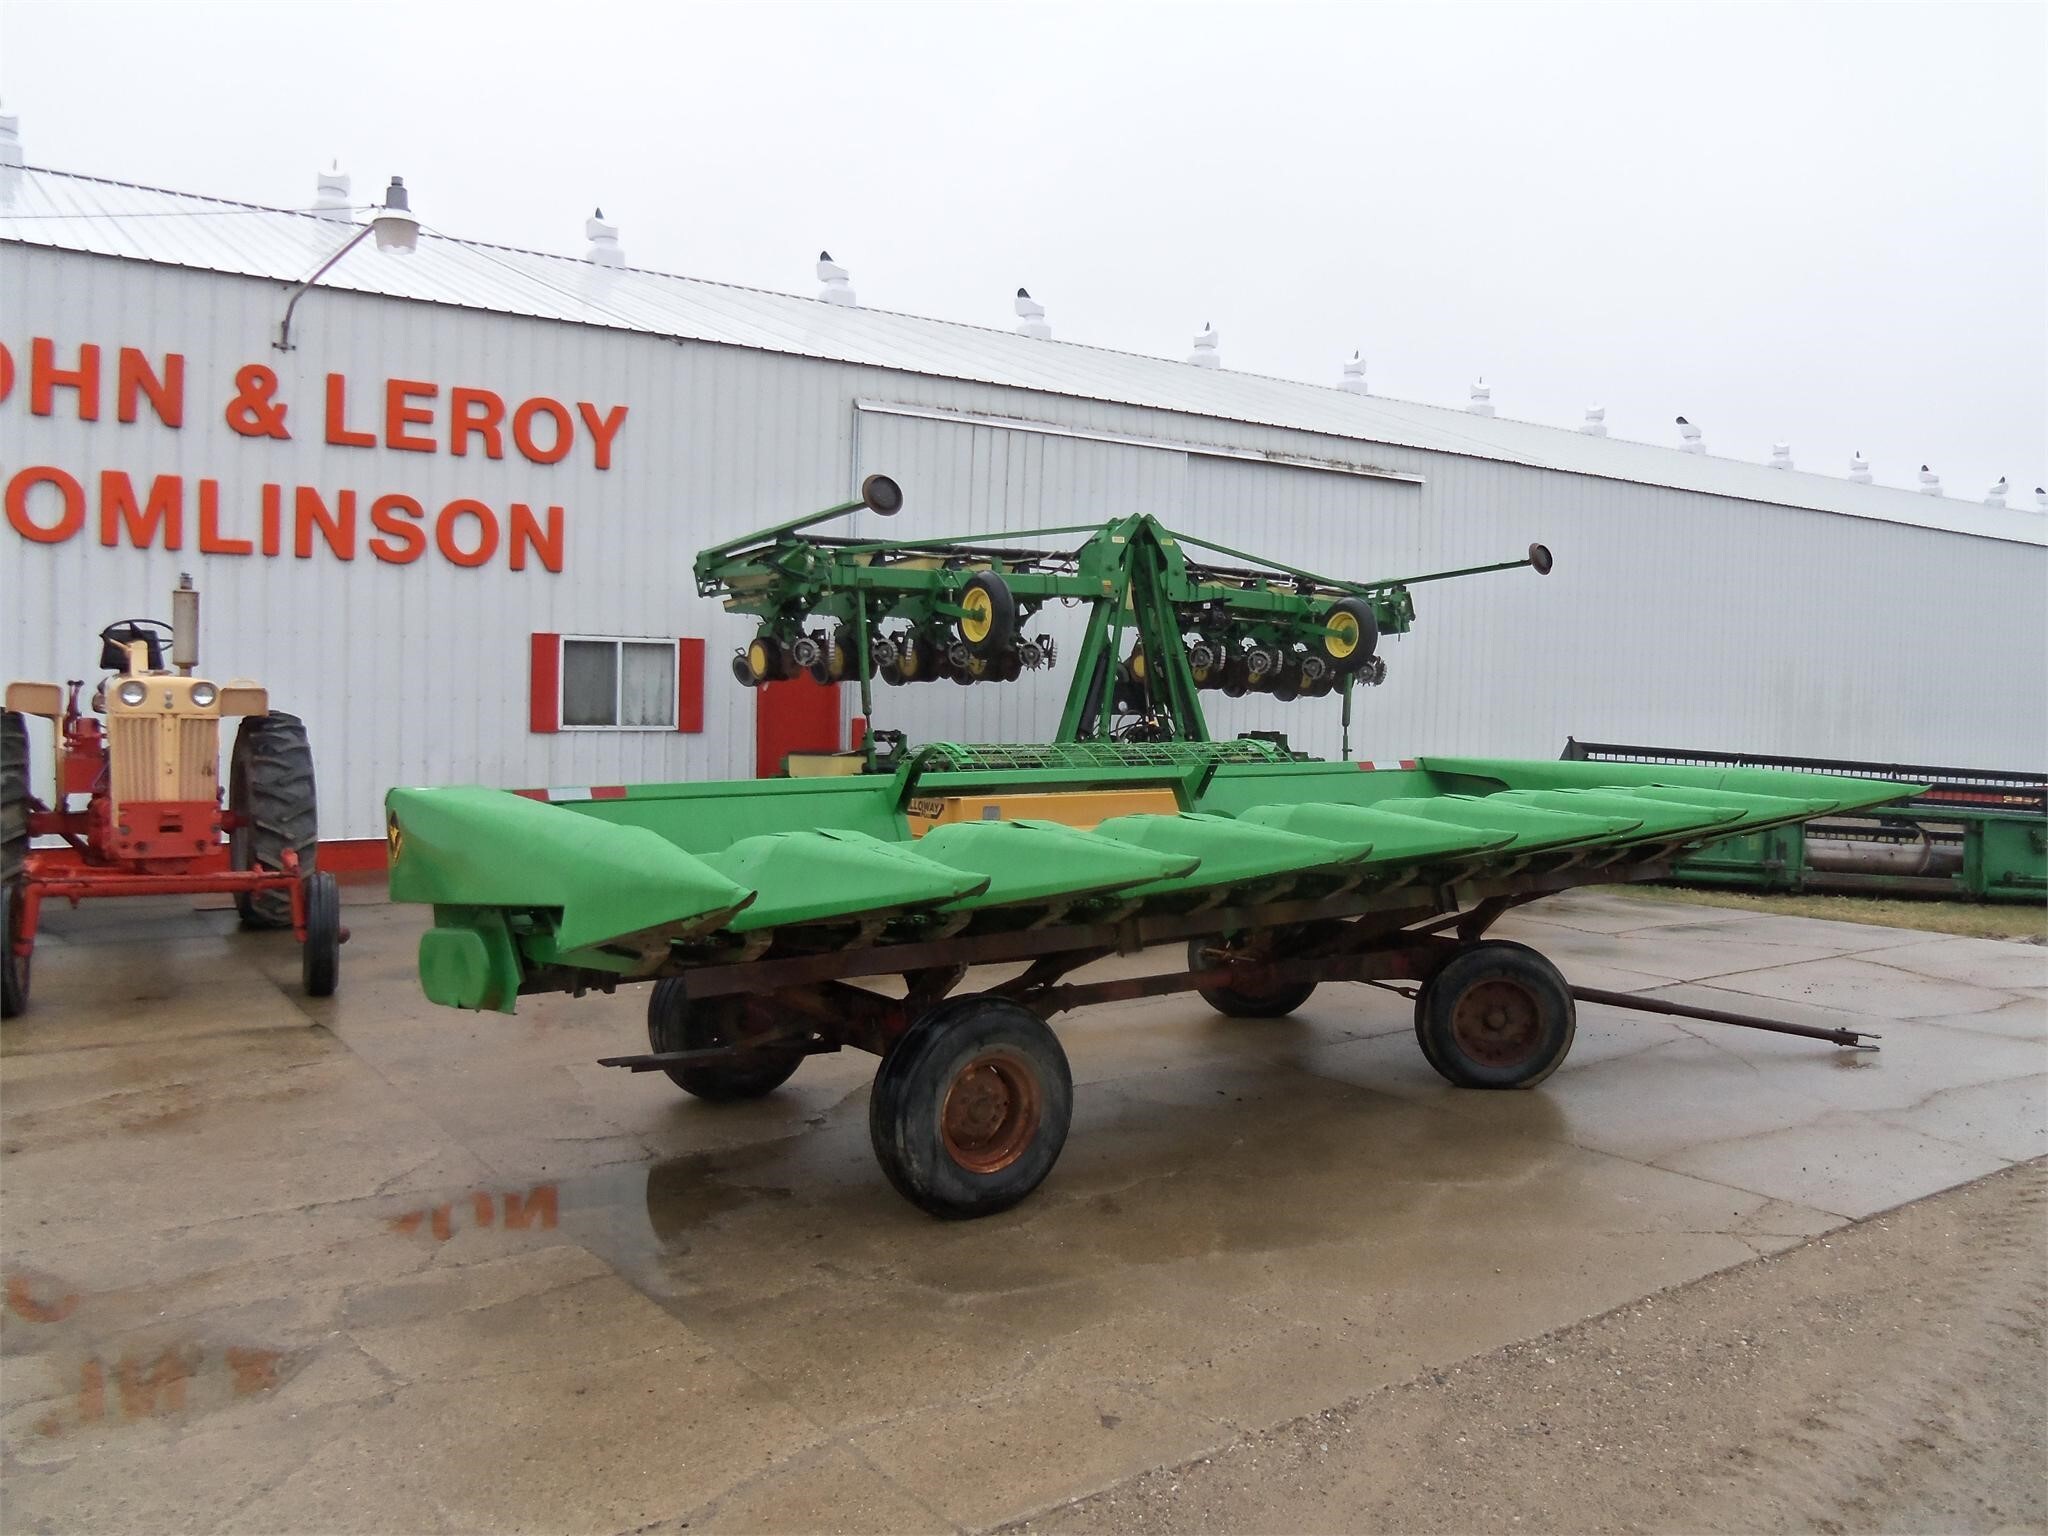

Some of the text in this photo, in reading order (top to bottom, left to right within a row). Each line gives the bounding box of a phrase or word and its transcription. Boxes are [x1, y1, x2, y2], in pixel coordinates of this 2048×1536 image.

[0, 337, 628, 470] HN & LEROY
